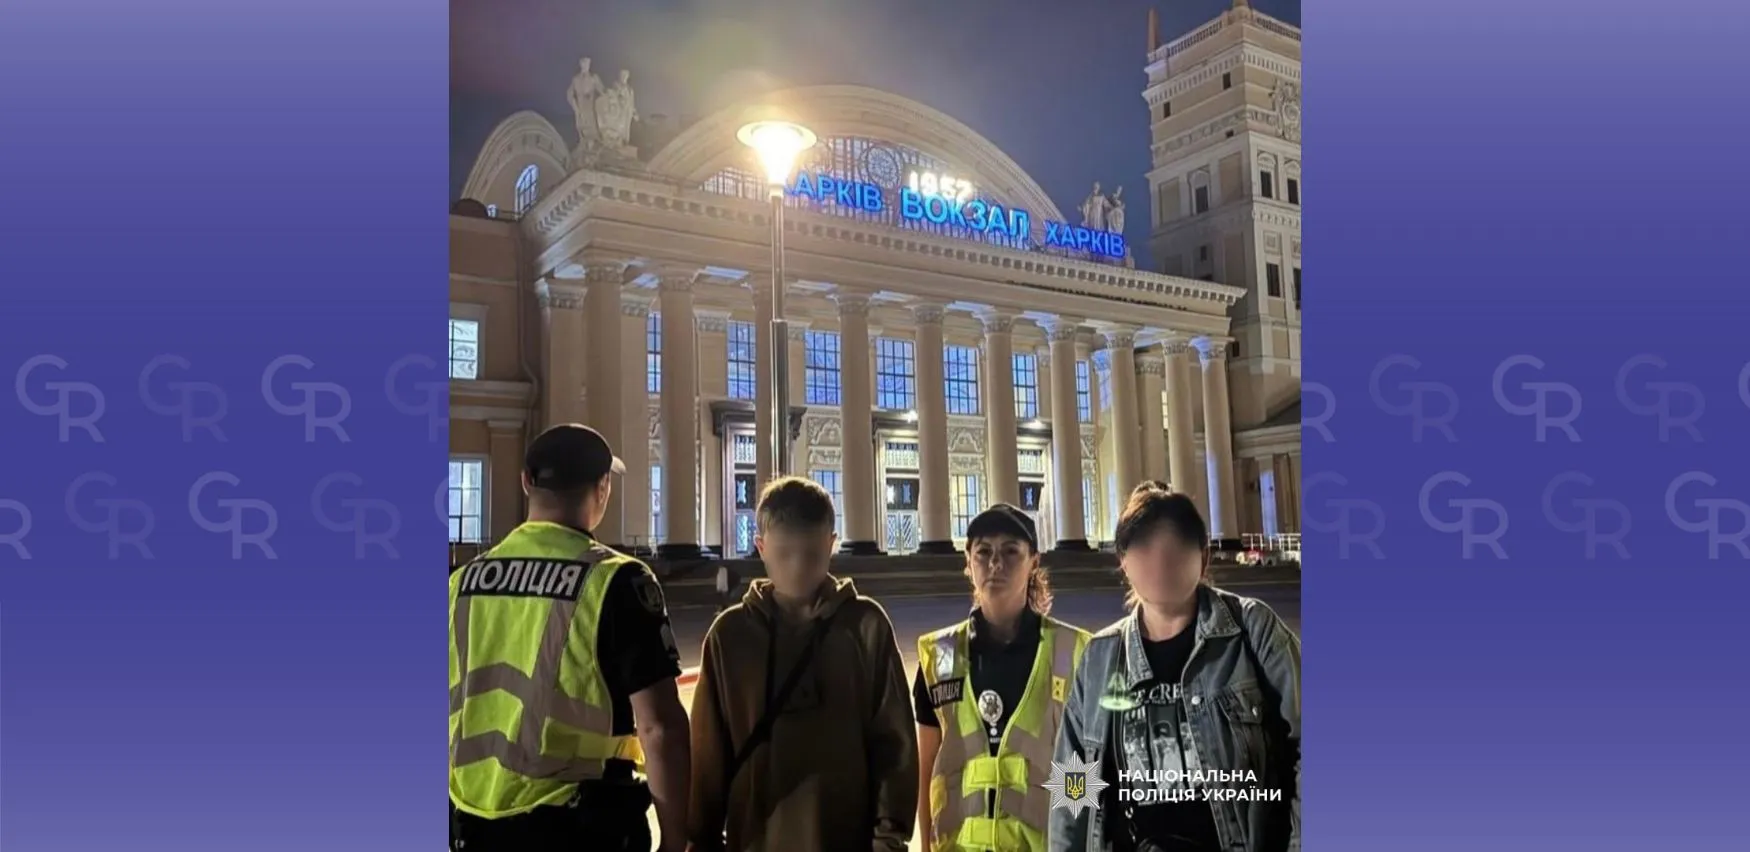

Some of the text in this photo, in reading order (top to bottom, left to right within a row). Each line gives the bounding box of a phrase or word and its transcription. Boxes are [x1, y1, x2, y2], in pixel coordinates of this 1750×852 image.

[784, 171, 1125, 258] АРКІВ ВОКЗАЛ ХАРКІВ
[462, 560, 583, 597] ПОЛІЦІЯ
